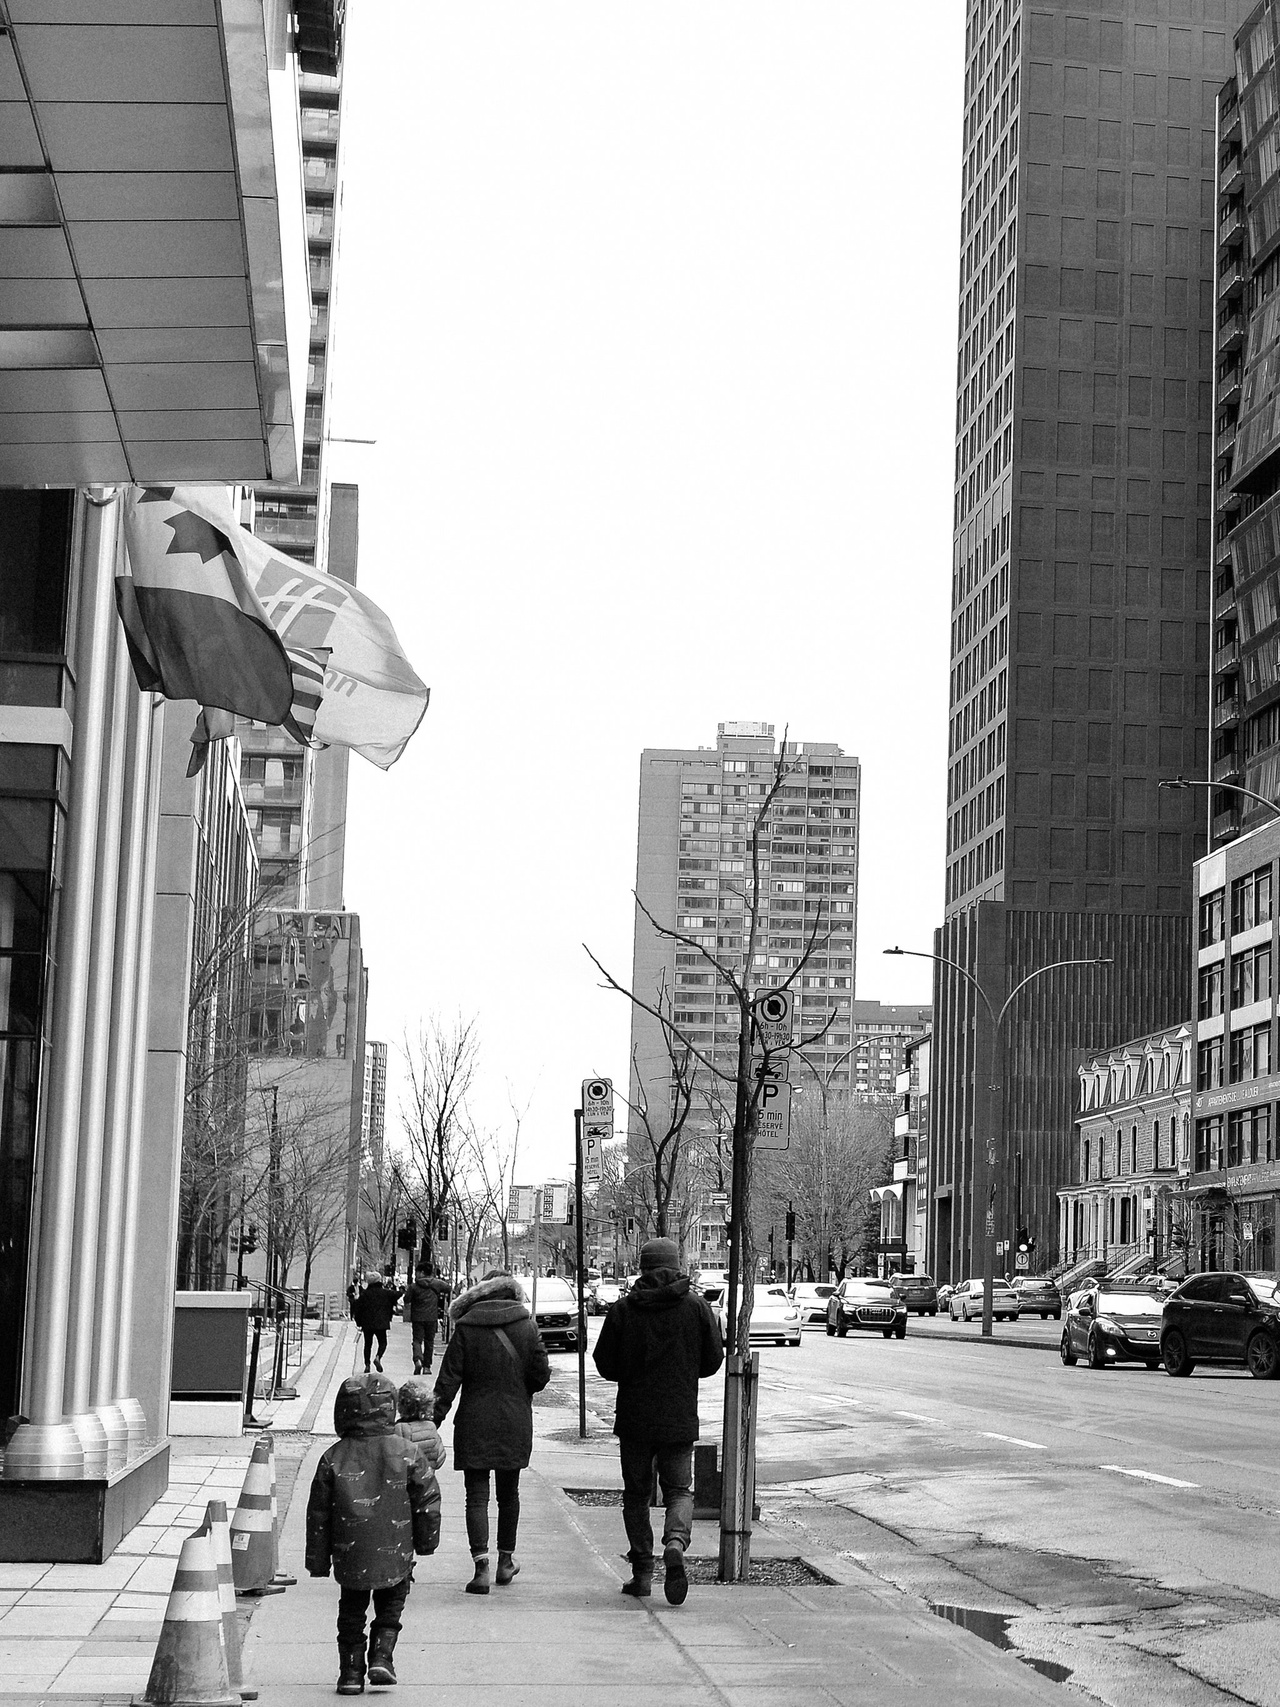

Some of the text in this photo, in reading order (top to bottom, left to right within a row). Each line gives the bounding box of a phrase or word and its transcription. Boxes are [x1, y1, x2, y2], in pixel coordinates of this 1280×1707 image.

[766, 1110, 783, 1120] min
[757, 1120, 783, 1130] ÉSERVÉ
[588, 1140, 596, 1155] P
